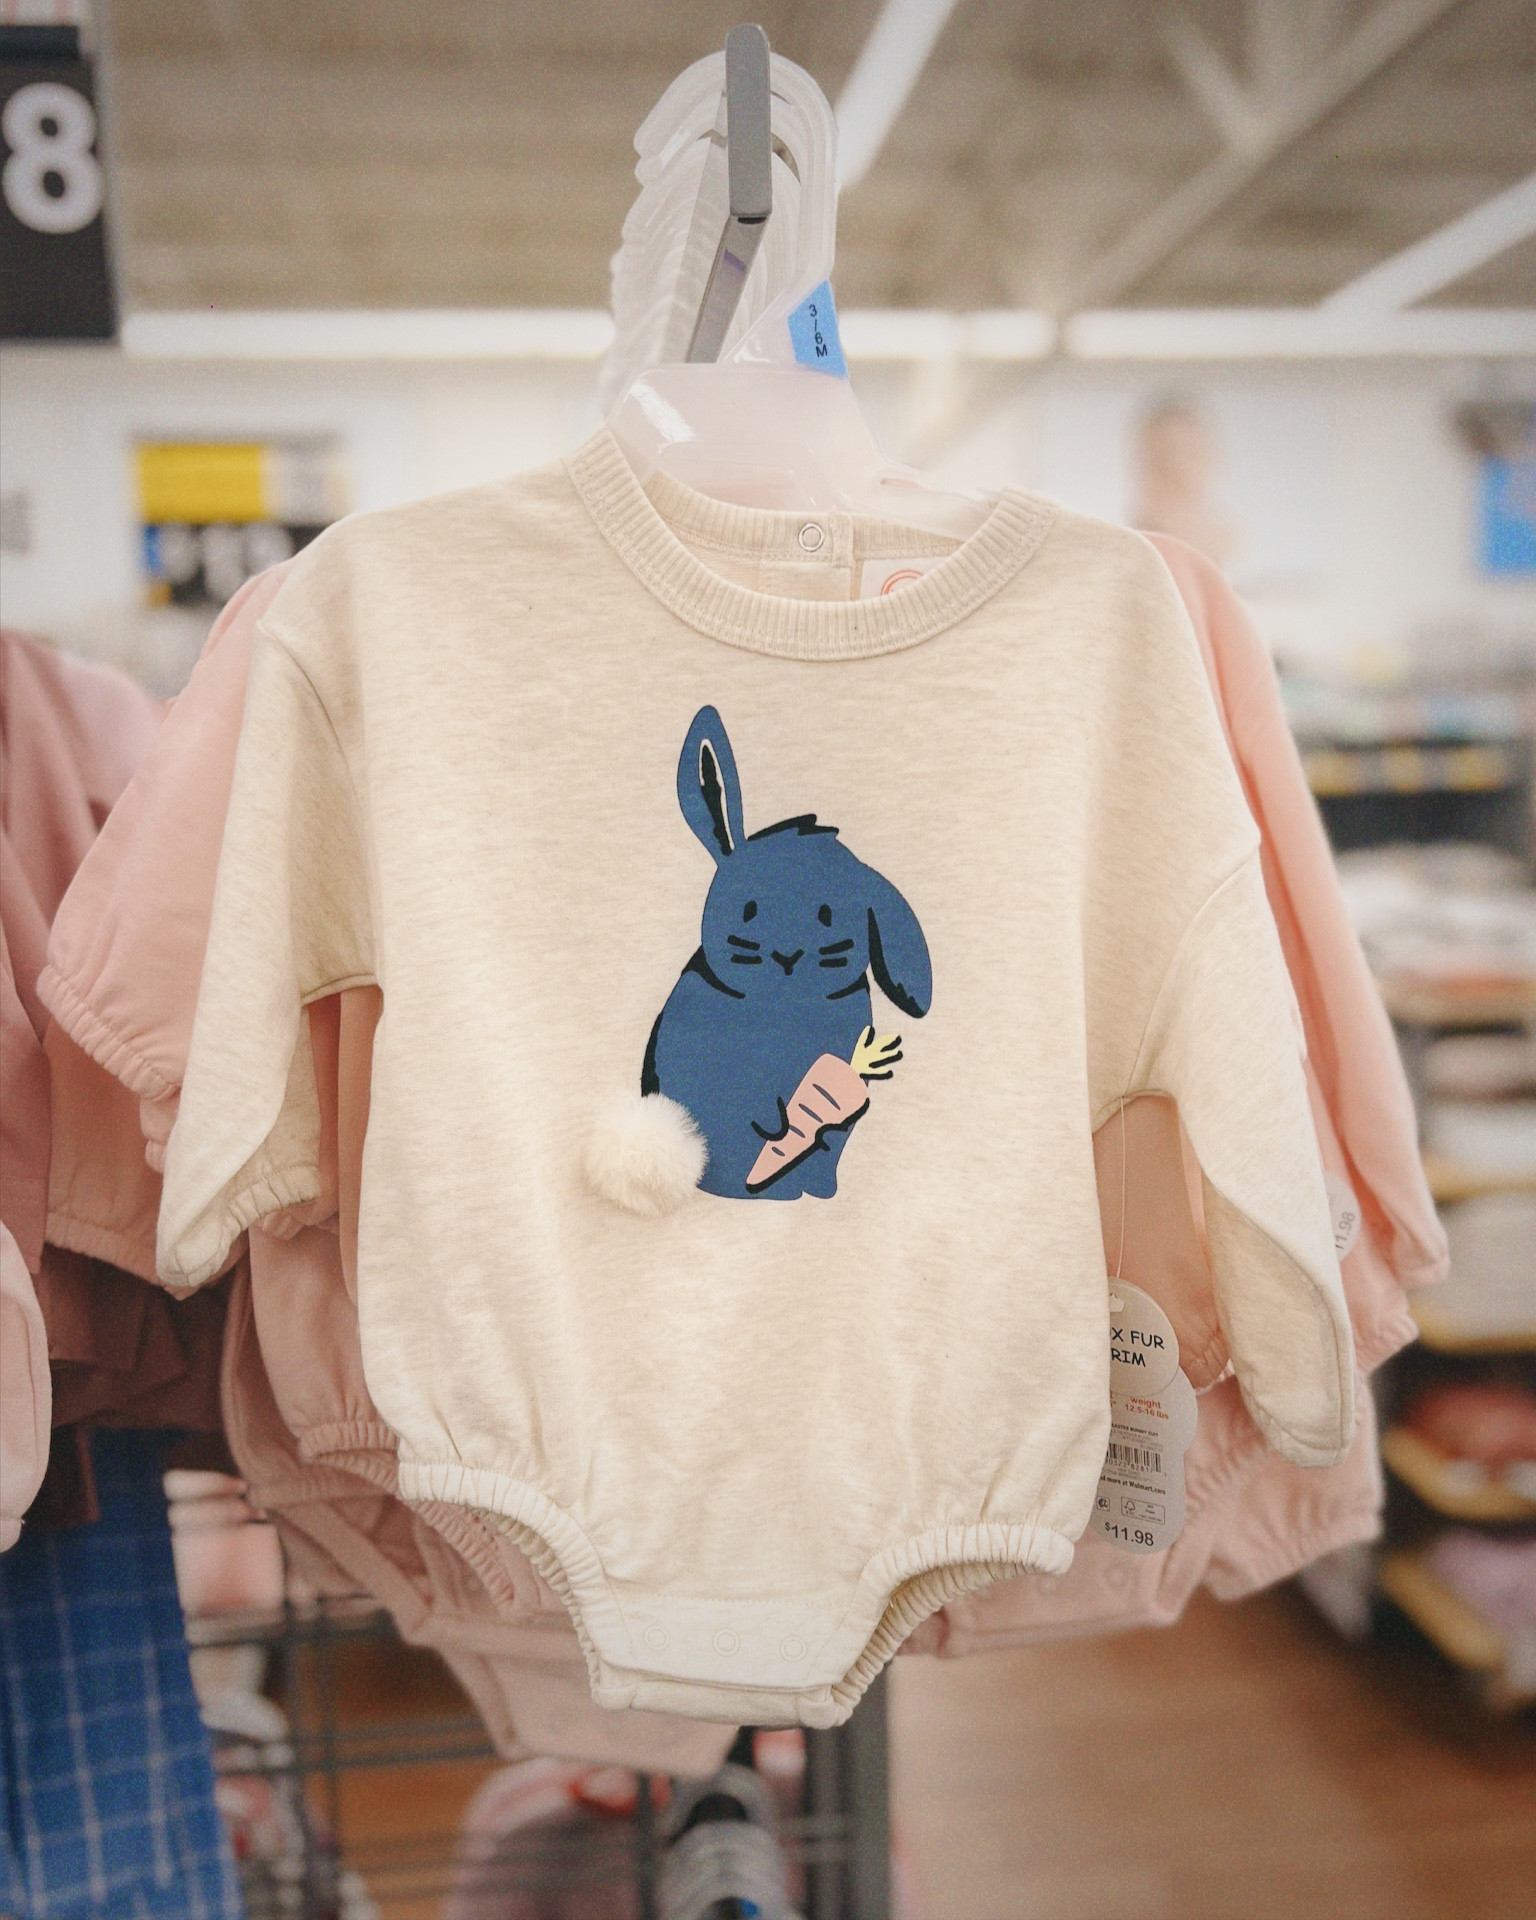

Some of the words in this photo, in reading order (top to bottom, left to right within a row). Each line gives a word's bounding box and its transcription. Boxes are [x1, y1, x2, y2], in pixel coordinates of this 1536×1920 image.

[1, 82, 101, 233] 8
[1130, 1330, 1165, 1350] FUR
[1111, 1347, 1147, 1368] RIM
[1105, 1521, 1154, 1546] $11.98
